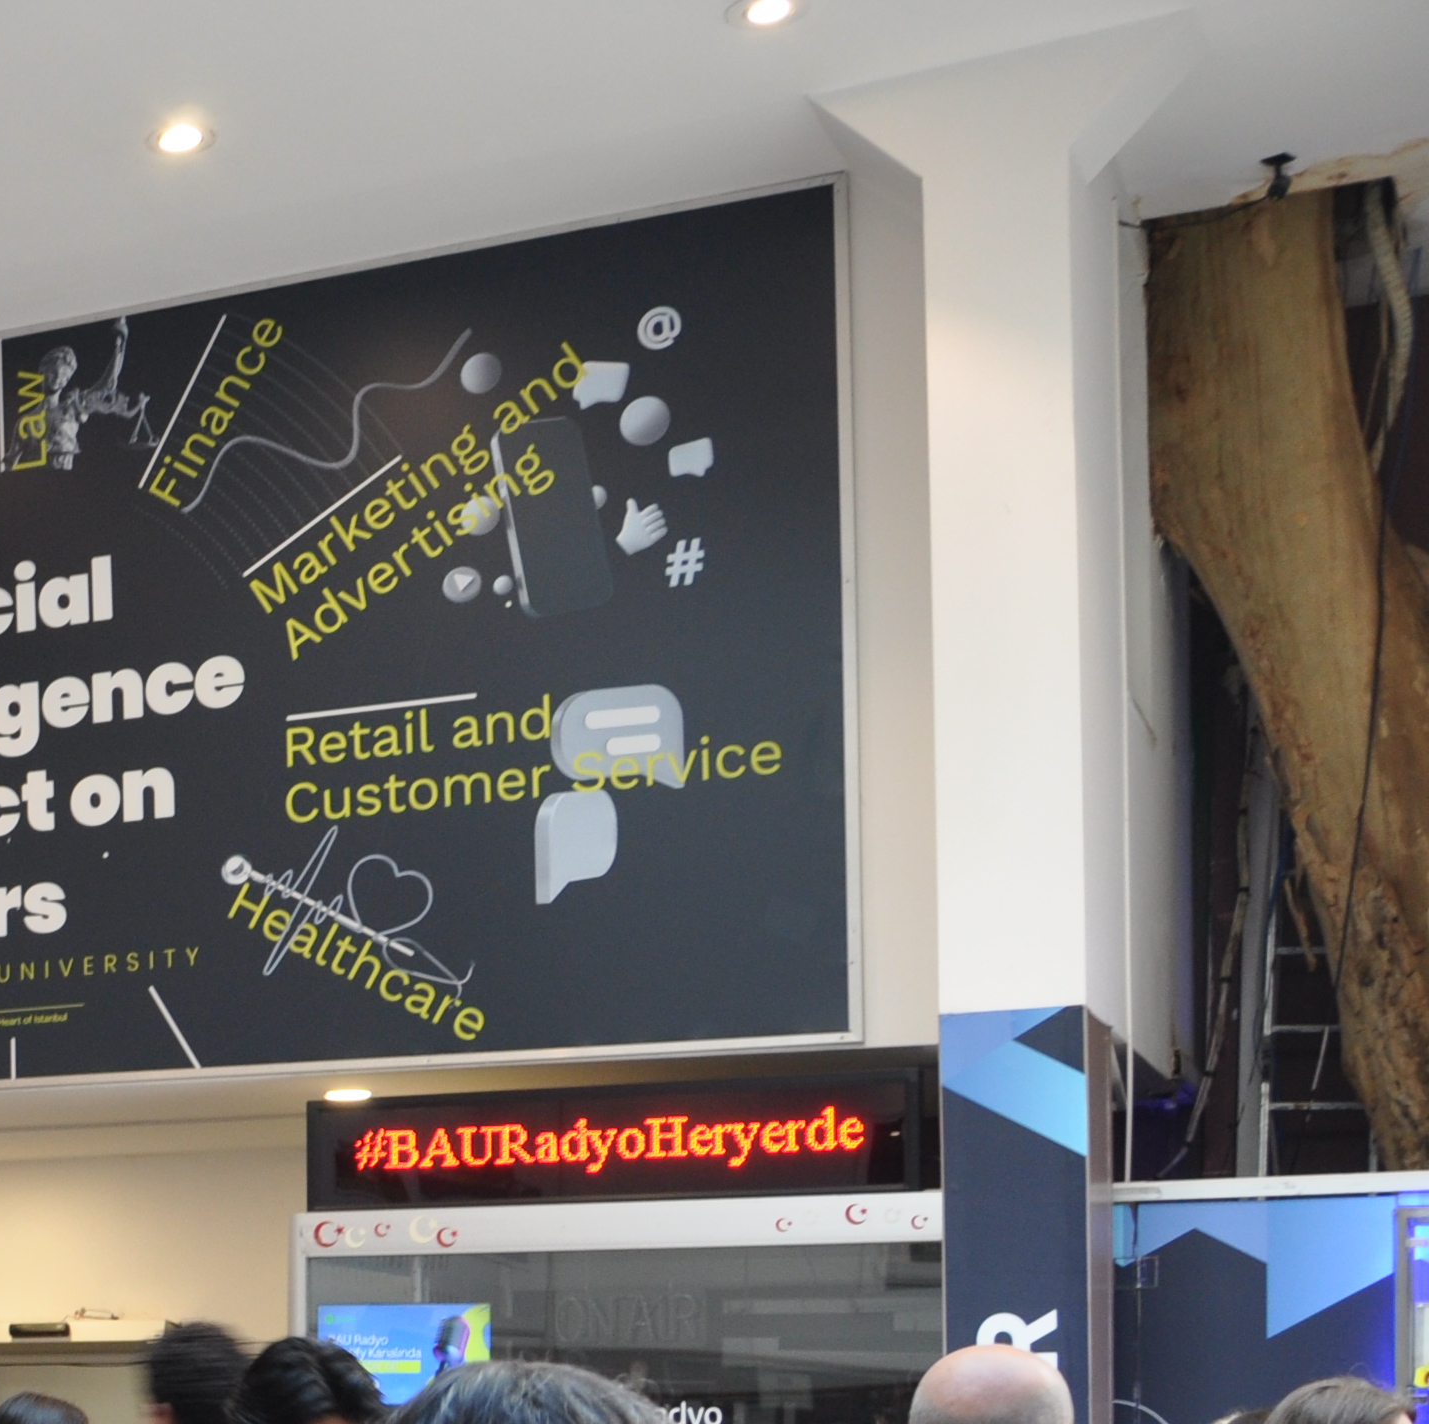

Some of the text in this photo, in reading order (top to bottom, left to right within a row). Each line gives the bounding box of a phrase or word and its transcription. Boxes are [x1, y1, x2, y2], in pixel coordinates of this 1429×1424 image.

[12, 370, 47, 472] Law
[149, 317, 284, 507] Finance
[248, 341, 588, 614] Marketing and
[284, 443, 556, 661] Advertising
[284, 693, 552, 768] Retail and
[69, 767, 176, 828] on
[284, 735, 783, 823] Customer Service
[227, 882, 486, 1042] Healthcare
[354, 1105, 865, 1174] #BAURadyoHeryerde
[353, 1333, 389, 1351] Radyo
